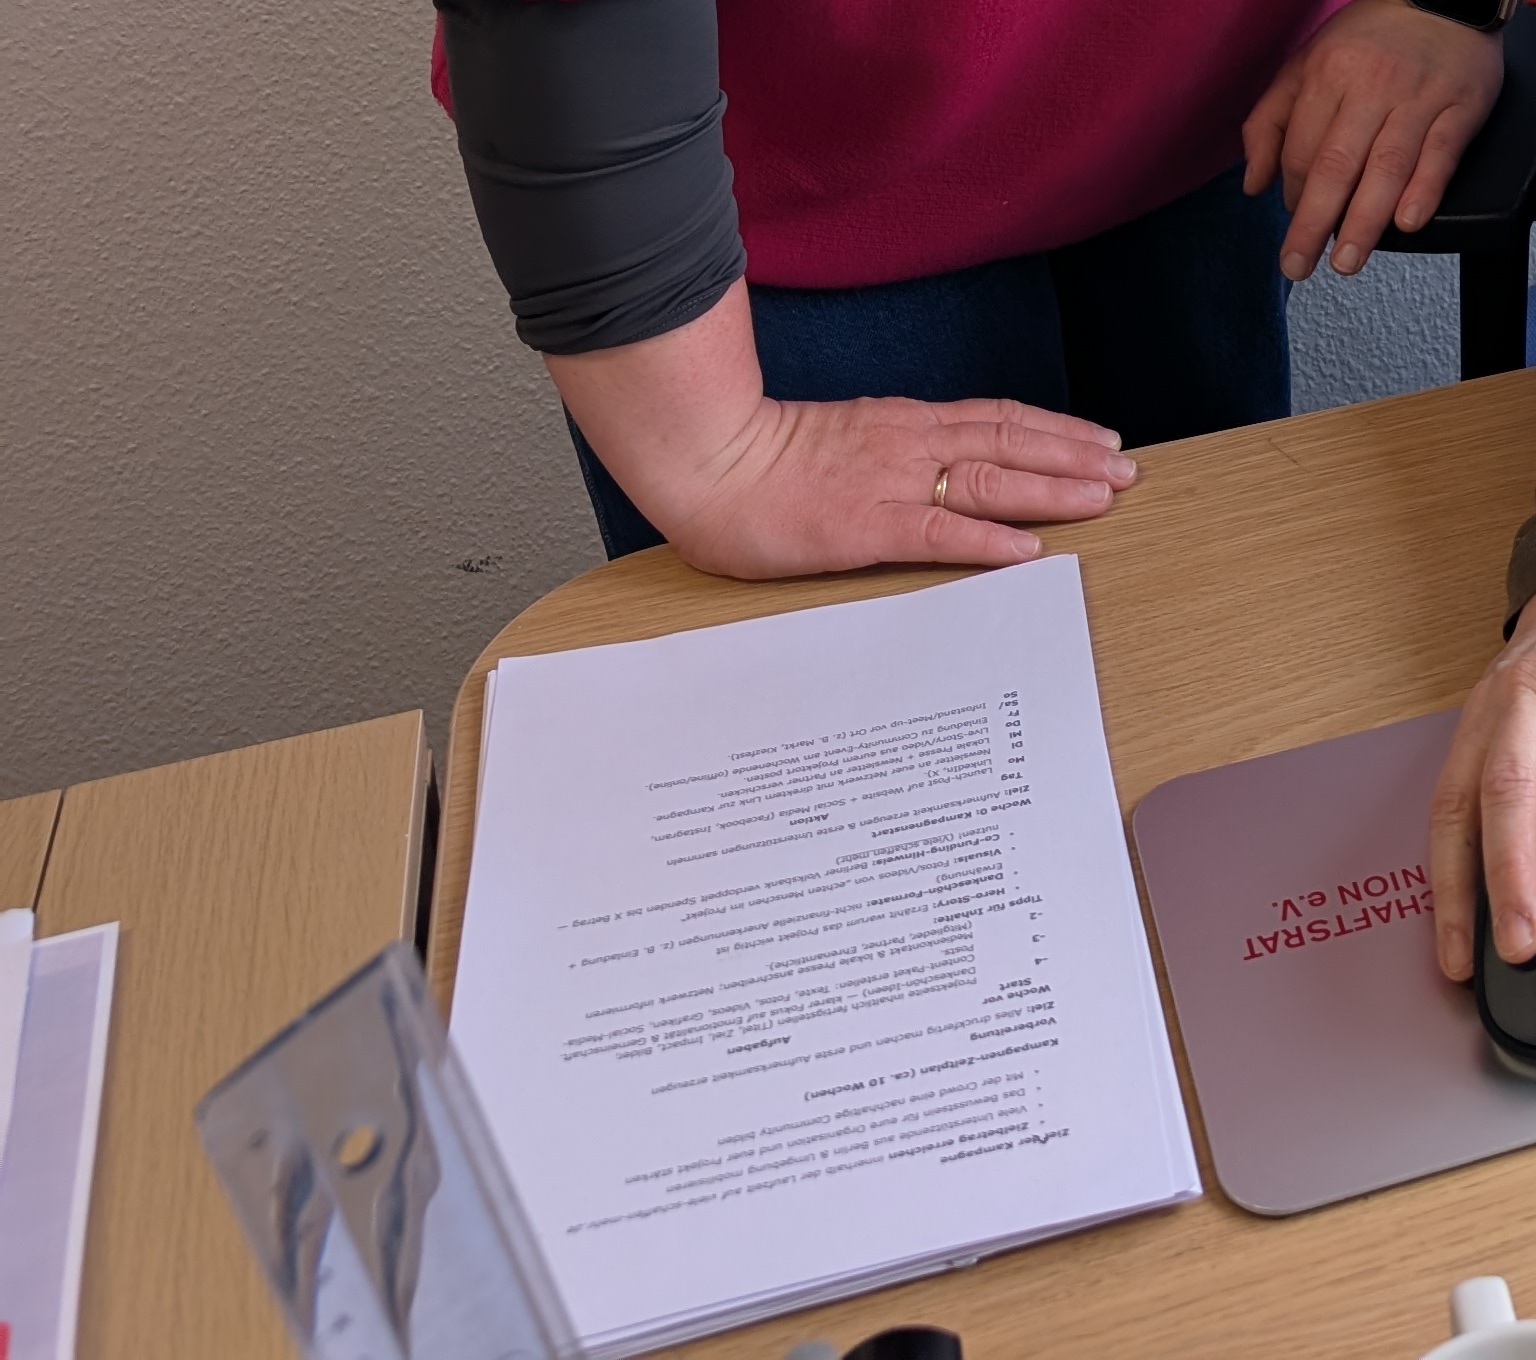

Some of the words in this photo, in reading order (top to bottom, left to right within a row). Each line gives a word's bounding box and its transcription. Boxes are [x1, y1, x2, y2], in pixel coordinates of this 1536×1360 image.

[1003, 690, 1018, 699] So
[998, 699, 1019, 710] Sa/
[1007, 709, 1020, 717] Fr
[1004, 719, 1021, 728] Do
[1007, 755, 1025, 764] Mo
[927, 766, 993, 787] Launch-Post
[1000, 771, 1023, 781] Tag
[861, 786, 904, 800] Website
[907, 781, 925, 792] auf
[1004, 784, 1030, 796] Ziel:
[778, 805, 810, 817] Media
[813, 798, 846, 811] Social
[912, 791, 1001, 816] Aufmerksamkeit
[990, 798, 1032, 812] Woche
[715, 811, 775, 830] (Facebook,
[789, 812, 829, 826] Aktion
[859, 811, 910, 827] erzeugen
[871, 811, 972, 838] Kampagnenstart
[650, 825, 711, 842] Instagram,
[816, 824, 845, 835] erste
[721, 831, 813, 855] Unterstützungen
[666, 850, 718, 866] sammeln
[953, 848, 1002, 864] Visuals:
[866, 872, 1004, 907] Dankeschön-Formate:
[932, 887, 1005, 909] Hero-Story:
[1008, 894, 1043, 907] Tipps
[889, 904, 929, 919] Erzählt
[986, 902, 1006, 912] für
[1271, 890, 1328, 922] e.V.
[933, 907, 984, 924] Inhalte:
[778, 927, 819, 942] Projekt
[822, 922, 843, 932] das
[715, 946, 730, 955] ist
[733, 936, 774, 951] wichtig
[998, 977, 1032, 991] Start
[1006, 984, 1051, 999] Woche
[981, 994, 1004, 1005] vor
[969, 1016, 1057, 1041] Vorbereitung
[726, 1035, 792, 1055] Aufgaben
[919, 1037, 1059, 1074] Kampagnen-Zeitplan
[890, 1067, 916, 1080] (ca.
[868, 1076, 885, 1088] 10
[803, 1081, 865, 1102] Wochen)
[952, 1121, 1029, 1144] Zielbetrag
[888, 1138, 954, 1160] erreichen
